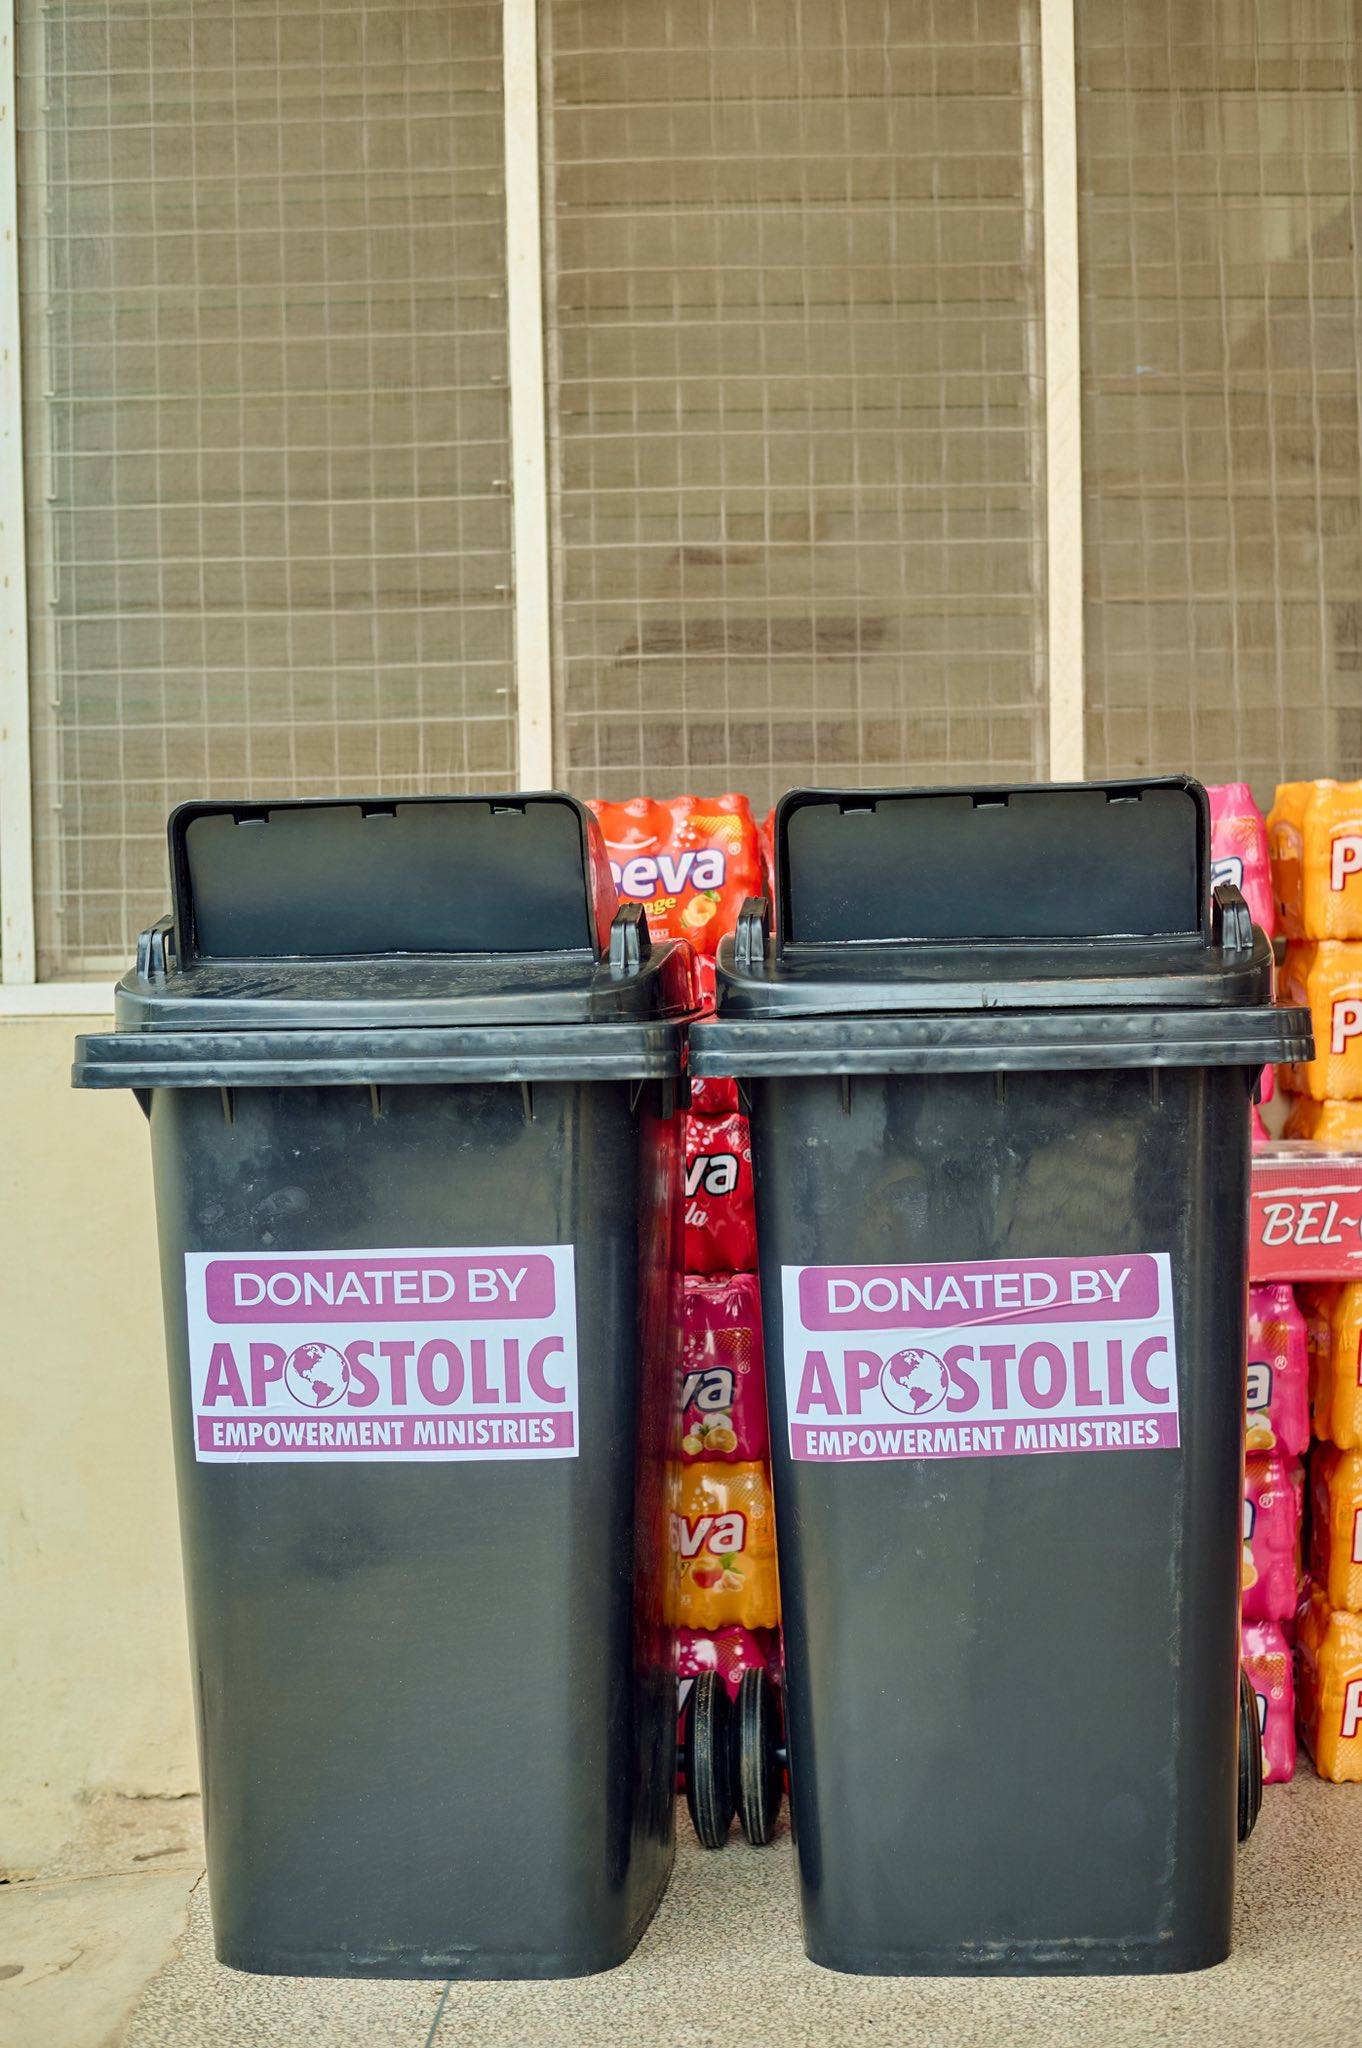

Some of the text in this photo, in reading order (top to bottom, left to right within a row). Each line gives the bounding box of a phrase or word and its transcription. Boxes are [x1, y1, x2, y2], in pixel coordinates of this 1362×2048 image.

[233, 1267, 528, 1307] DONATED BY
[827, 1267, 1132, 1314] DONATED BY
[212, 1418, 556, 1447] EMPOWERMENT MINISTRIES
[806, 1419, 1160, 1456] EMPOWERMENT MINISTRIES
